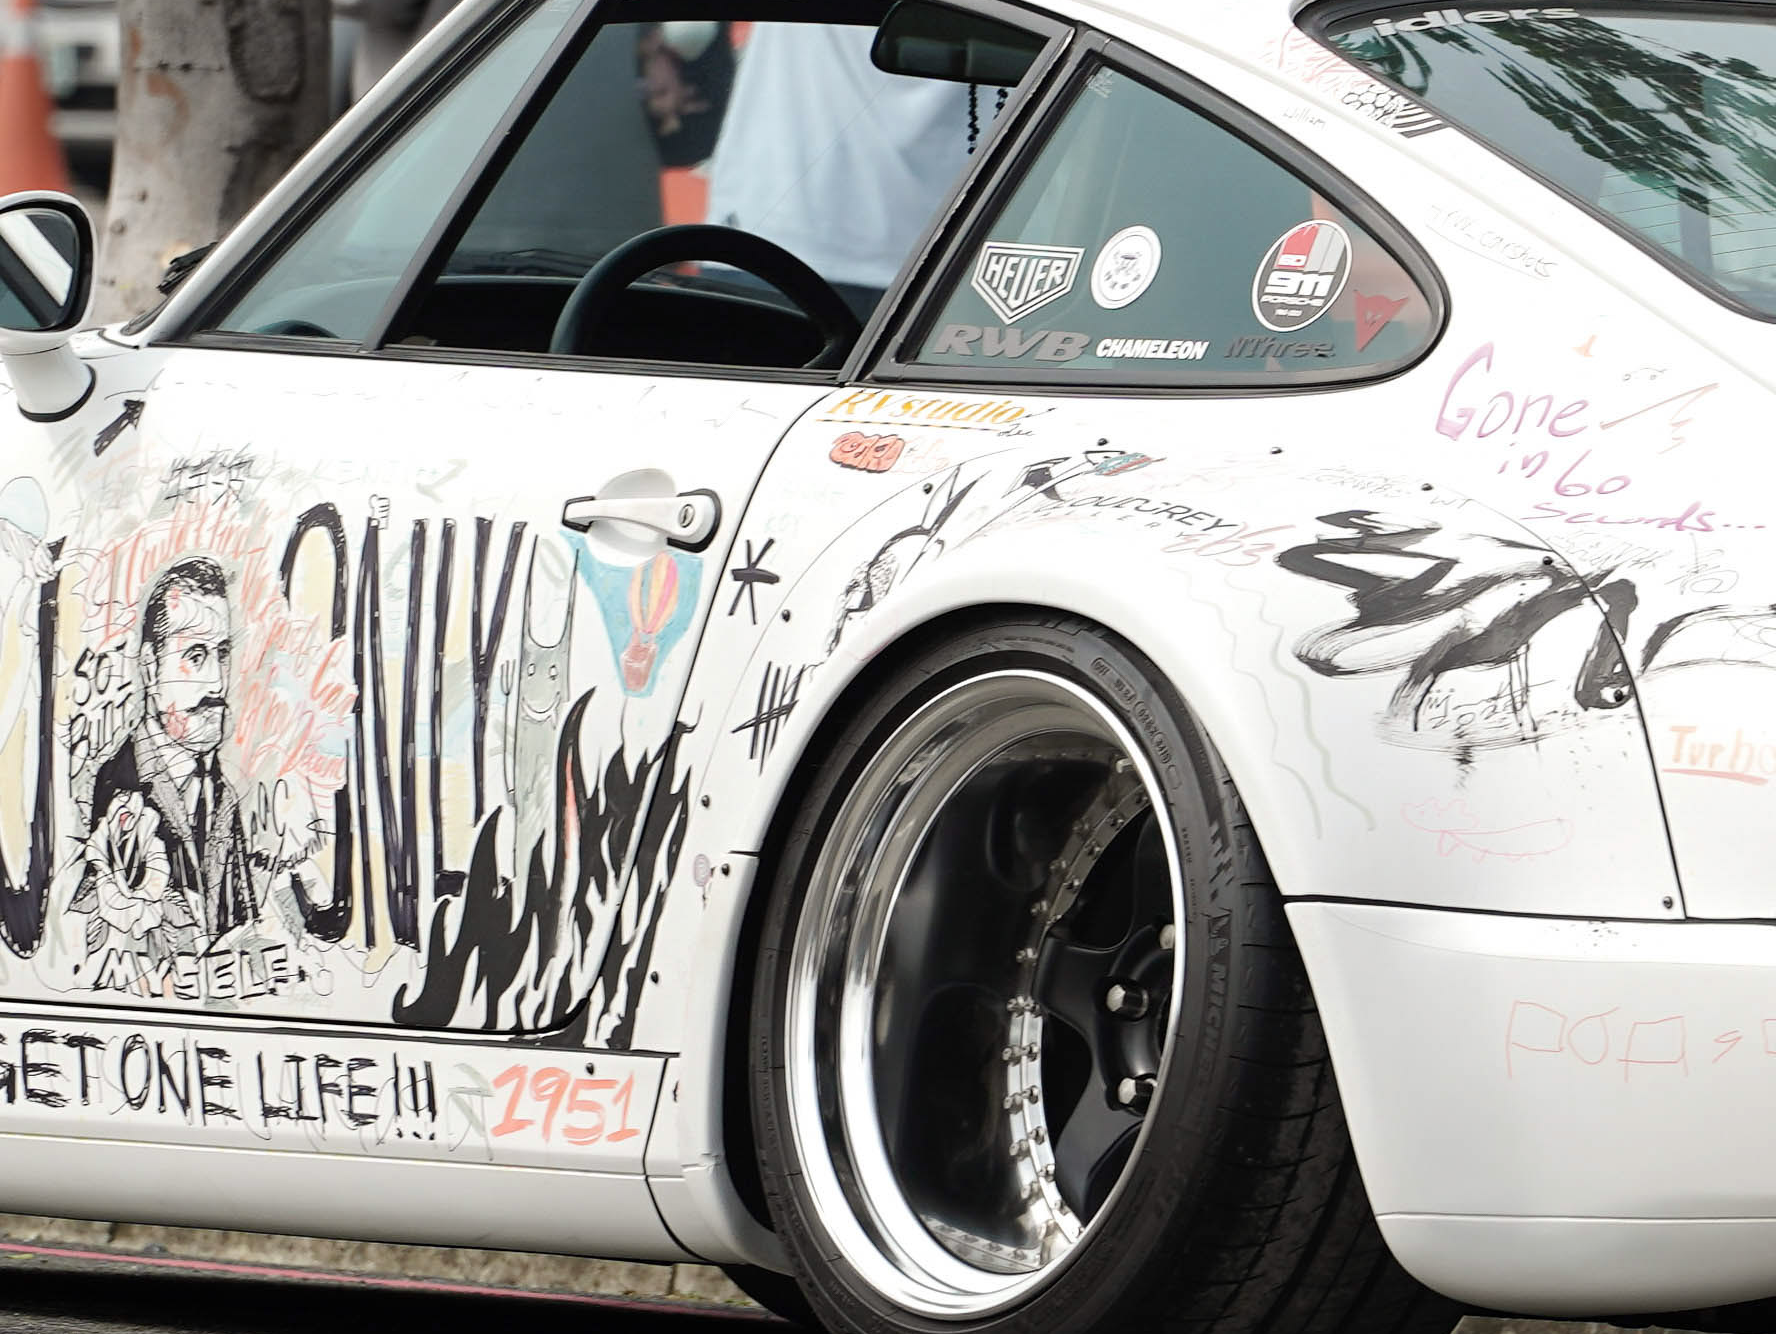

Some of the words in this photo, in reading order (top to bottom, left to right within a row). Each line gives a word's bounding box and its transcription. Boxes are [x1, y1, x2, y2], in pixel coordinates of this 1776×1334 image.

[1372, 6, 1580, 38] idlers
[985, 255, 1067, 311] HEUER
[1260, 294, 1326, 307] PORSCHE
[1264, 270, 1334, 297] 911
[933, 323, 1092, 362] RWB
[1096, 338, 1209, 360] CHAMELEON
[1435, 341, 1590, 441] Gone
[1497, 442, 1549, 477] in
[1553, 450, 1632, 497] 60
[122, 1033, 238, 1126] ONE
[491, 1062, 642, 1145] 1951
